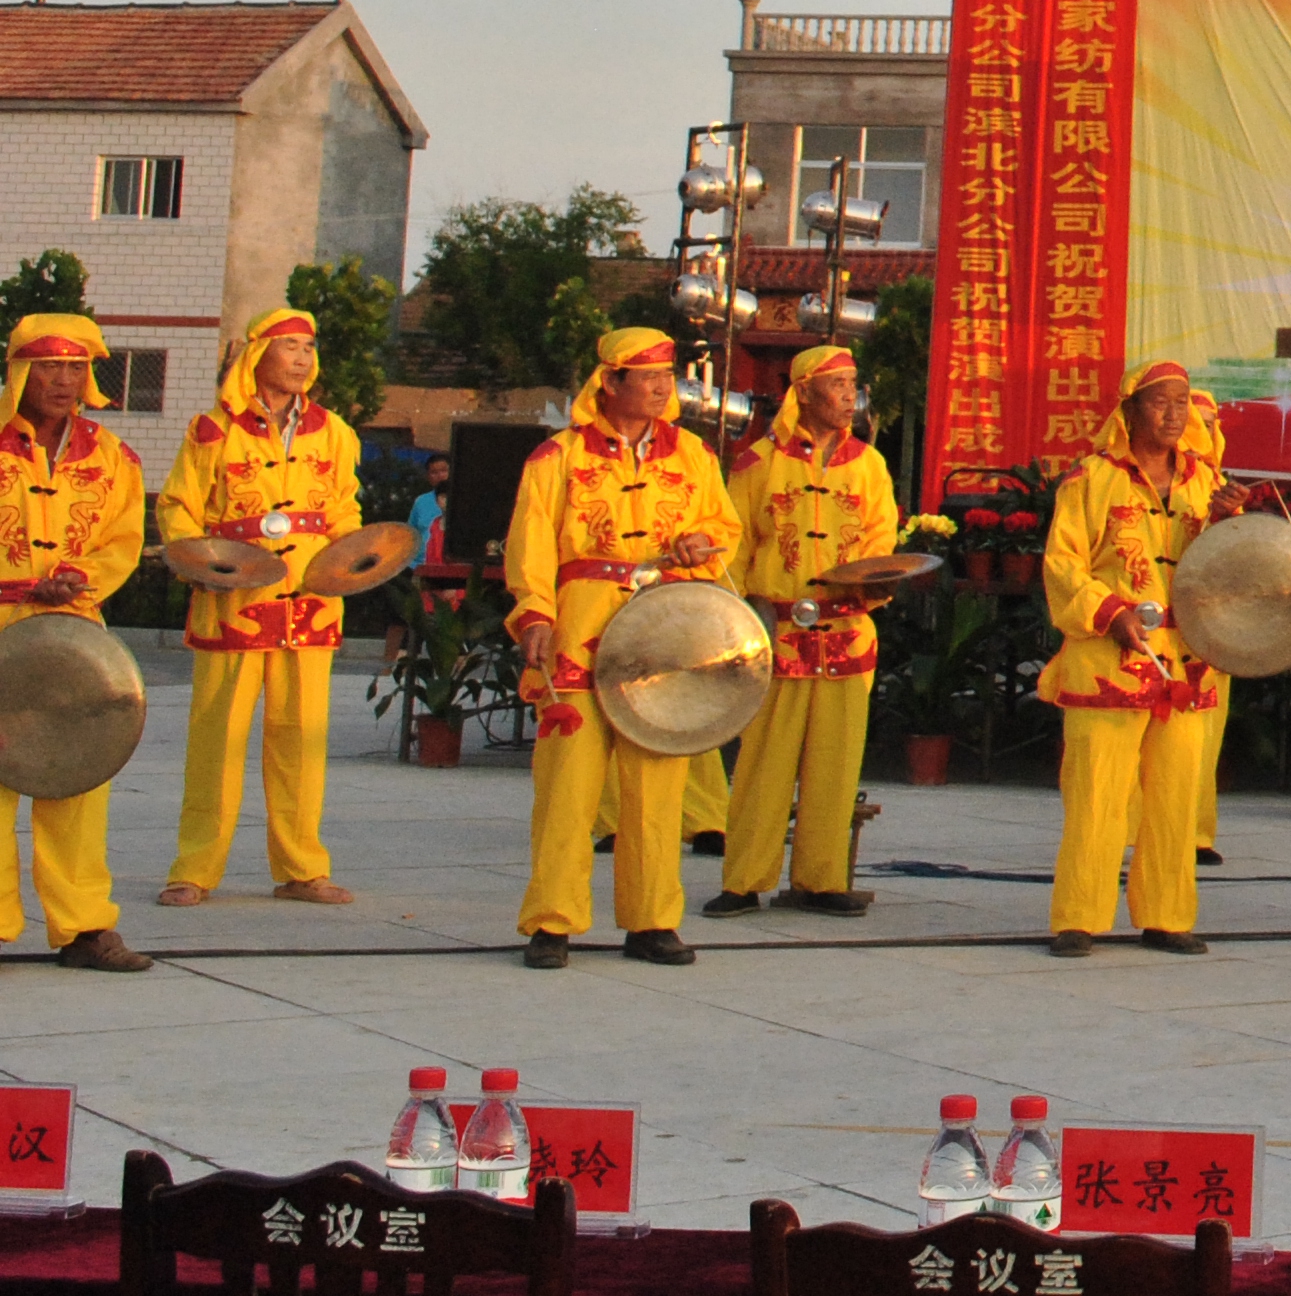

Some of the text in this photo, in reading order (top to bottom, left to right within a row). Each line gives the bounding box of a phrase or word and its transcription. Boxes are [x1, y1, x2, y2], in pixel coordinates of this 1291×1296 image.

[9, 1121, 55, 1164] 汉
[1074, 1160, 1236, 1217] 张景亮
[261, 1198, 427, 1254] 会议室
[907, 1243, 1085, 1295] 会议室
